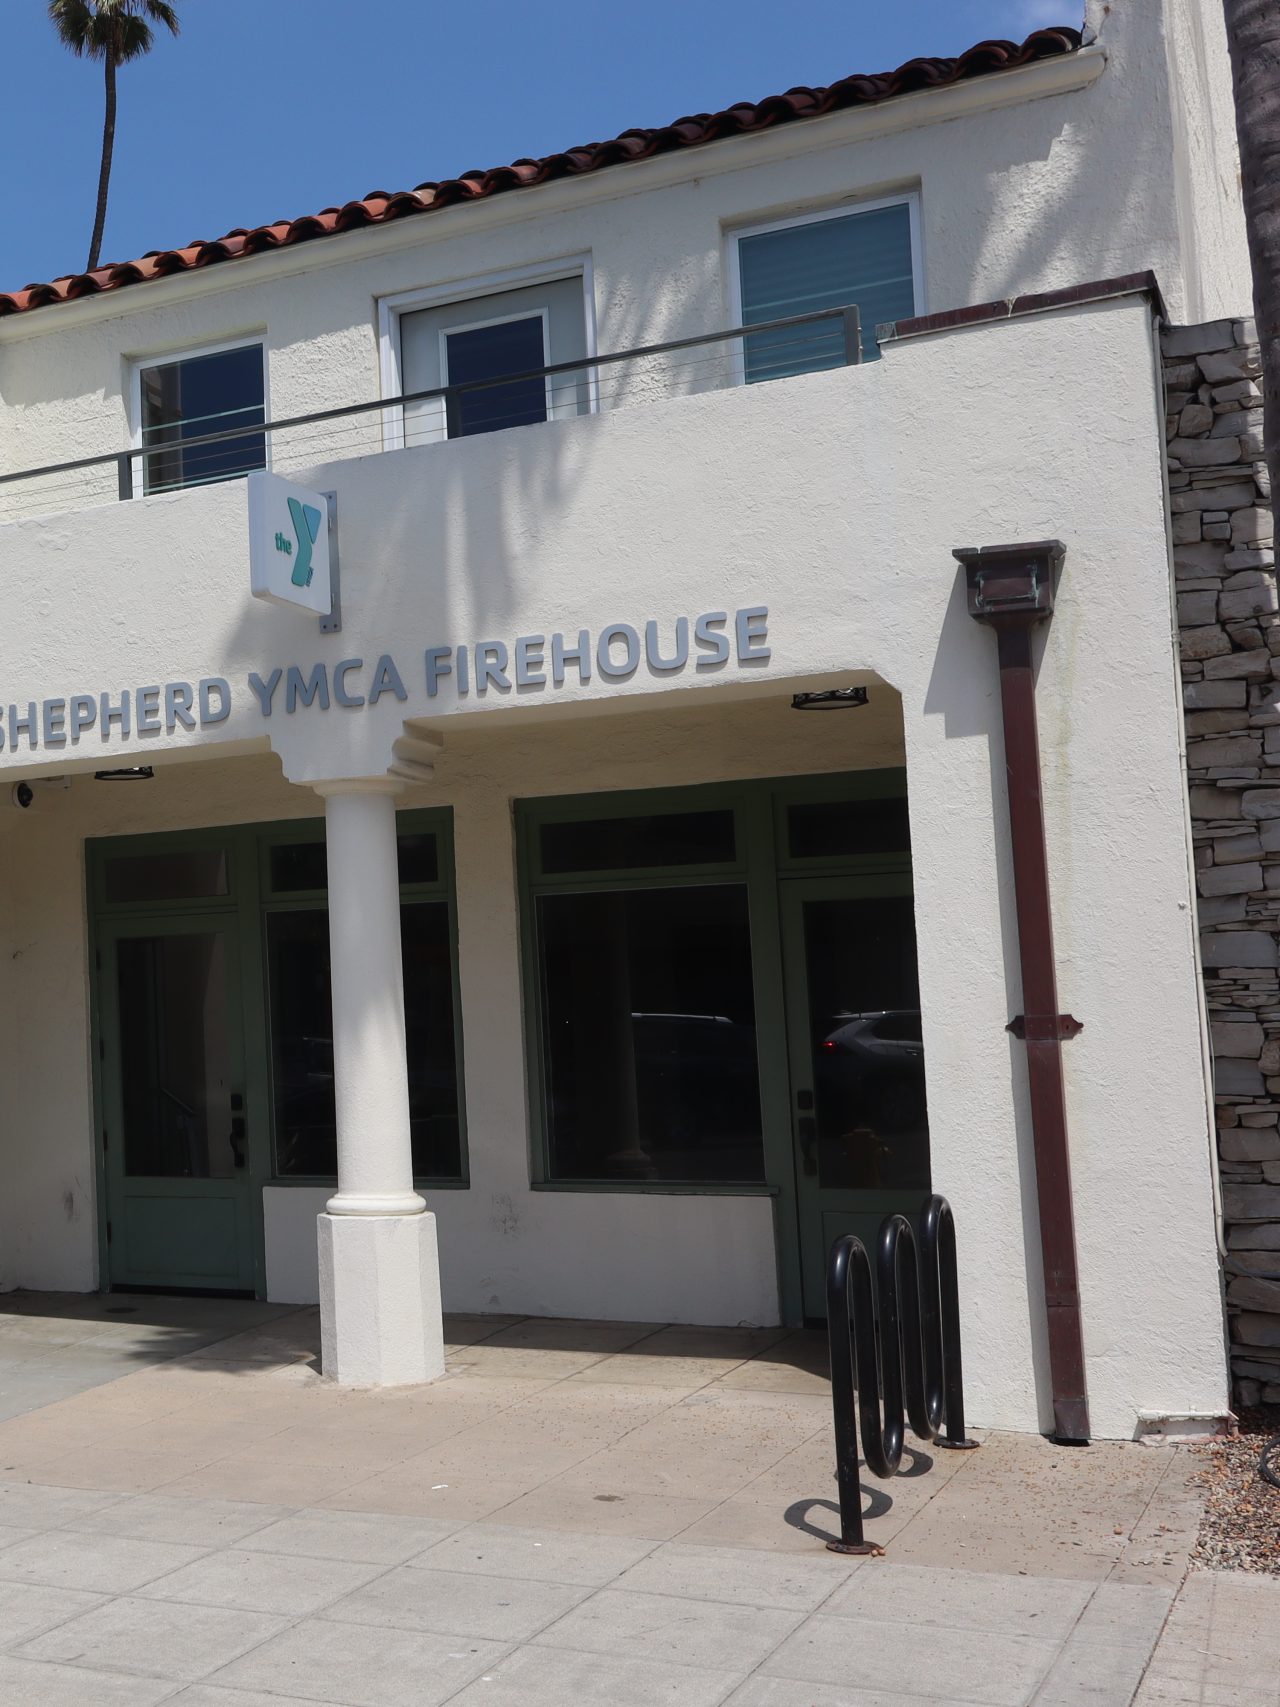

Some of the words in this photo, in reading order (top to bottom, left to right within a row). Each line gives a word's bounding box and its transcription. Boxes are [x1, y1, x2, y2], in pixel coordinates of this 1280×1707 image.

[275, 531, 292, 556] the
[247, 653, 408, 717] YMCA
[424, 605, 773, 698] FIREHOUSE
